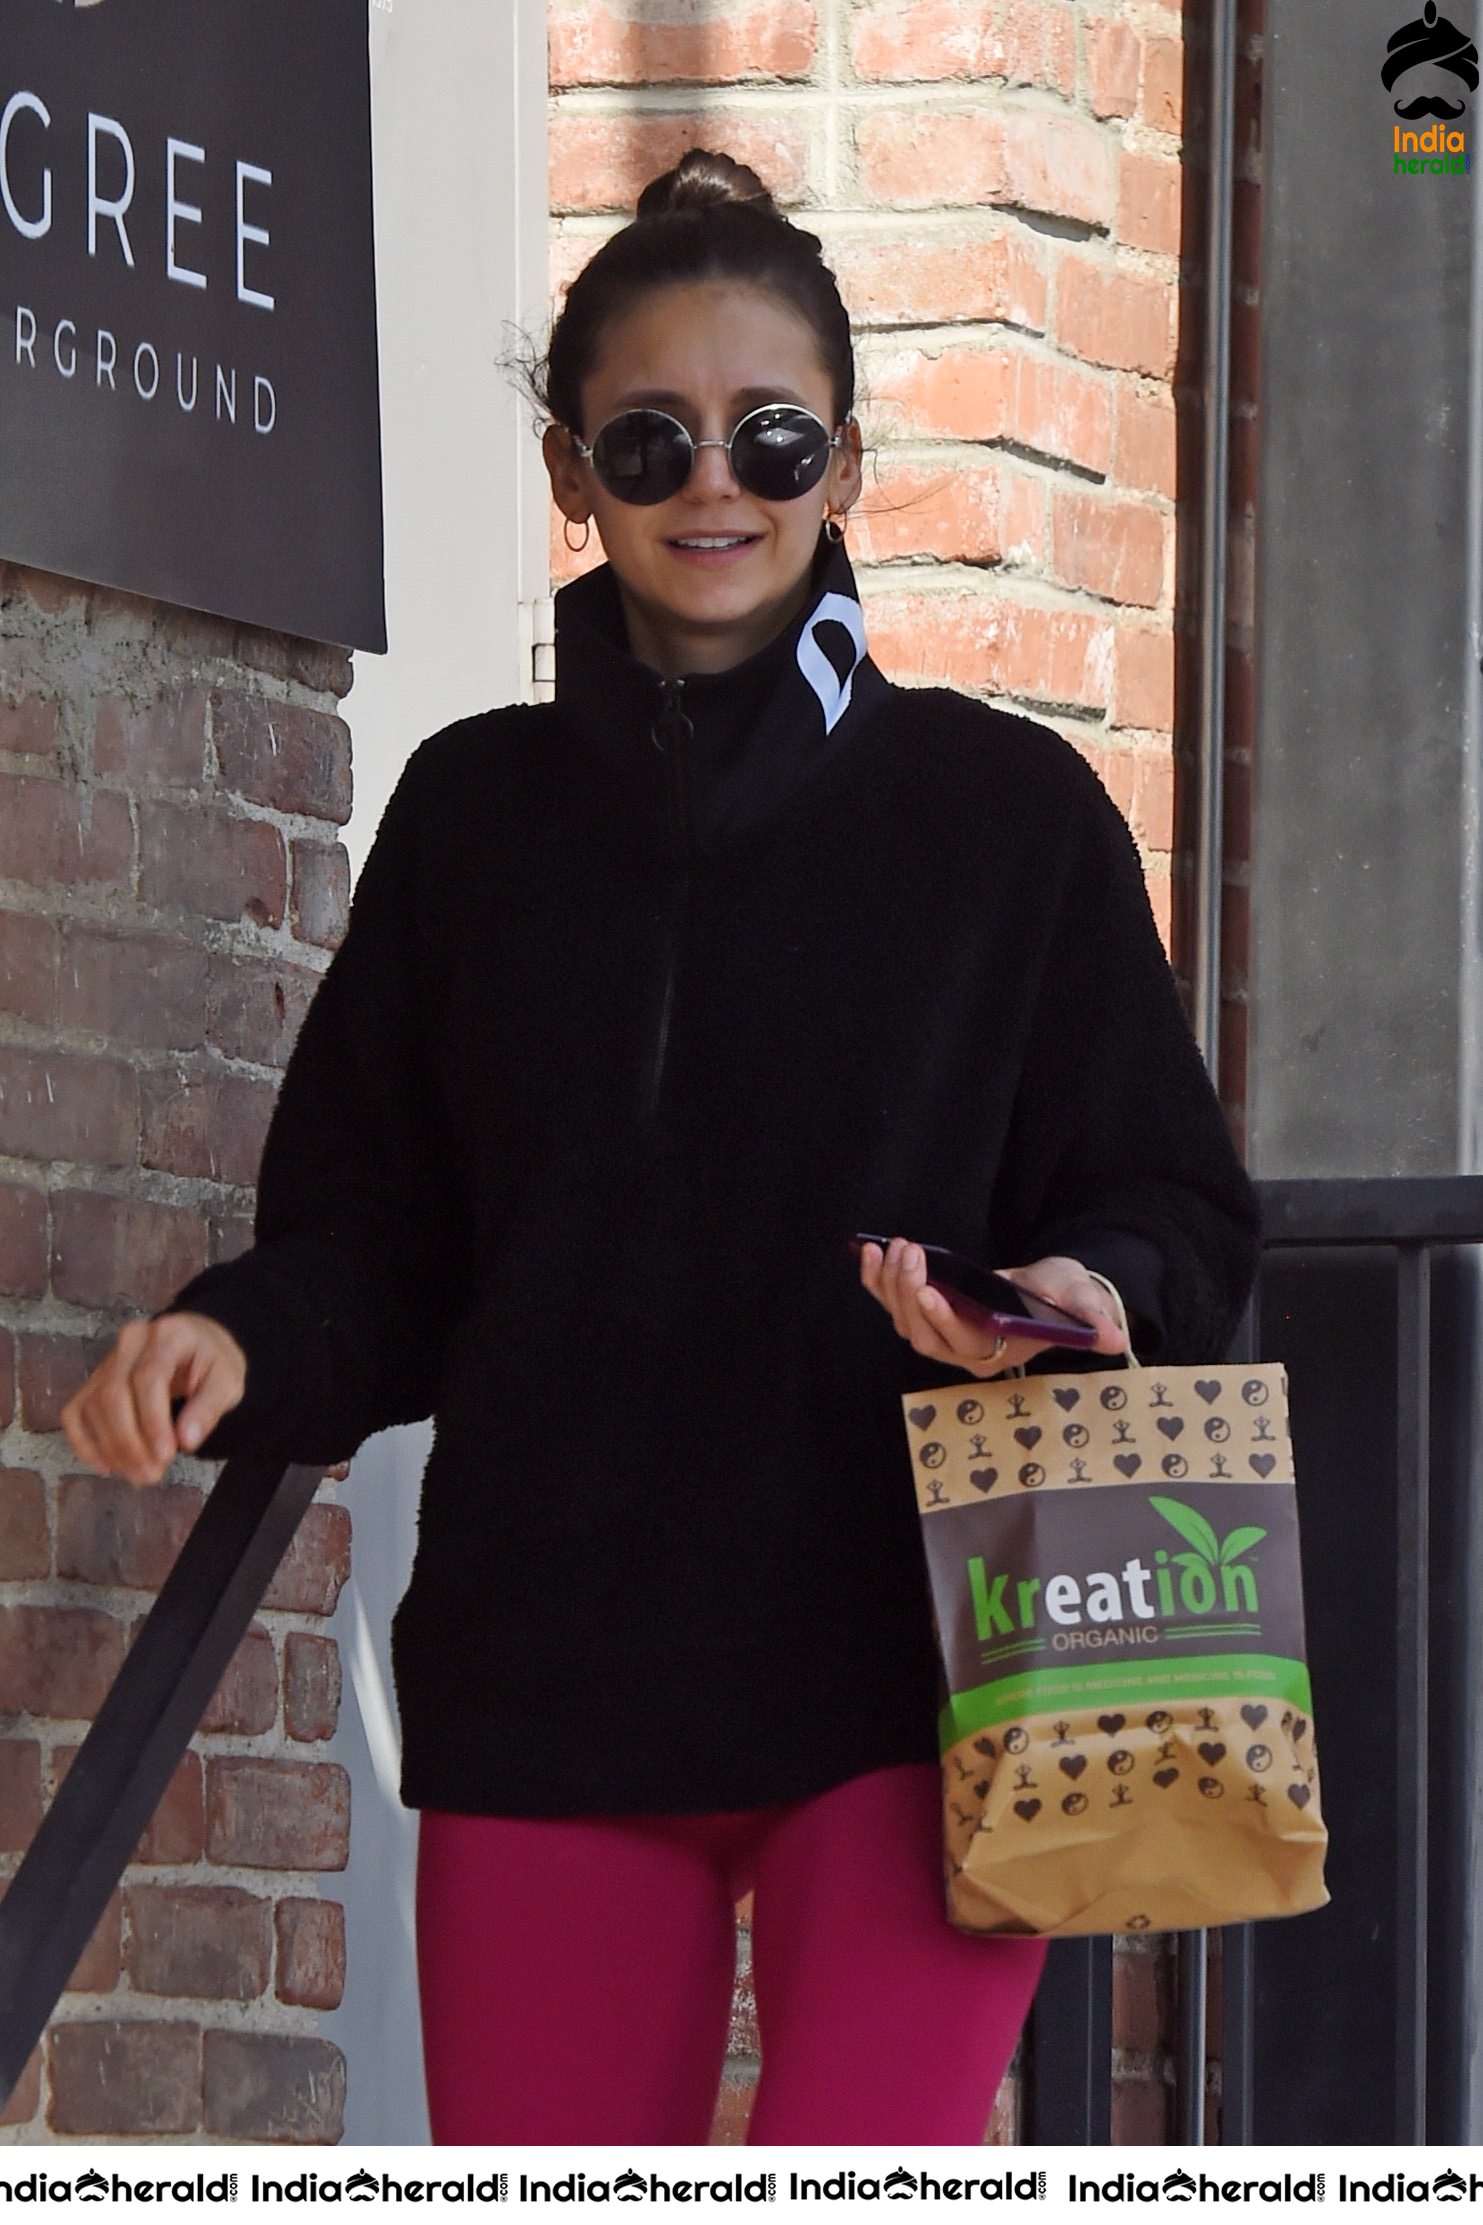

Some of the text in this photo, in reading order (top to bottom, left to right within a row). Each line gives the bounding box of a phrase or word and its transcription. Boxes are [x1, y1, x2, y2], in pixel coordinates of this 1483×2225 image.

[0, 90, 275, 310] GREE
[14, 305, 277, 435] RGROUND
[967, 1549, 1259, 1641] kreation
[1052, 1625, 1160, 1651] ORGANIC
